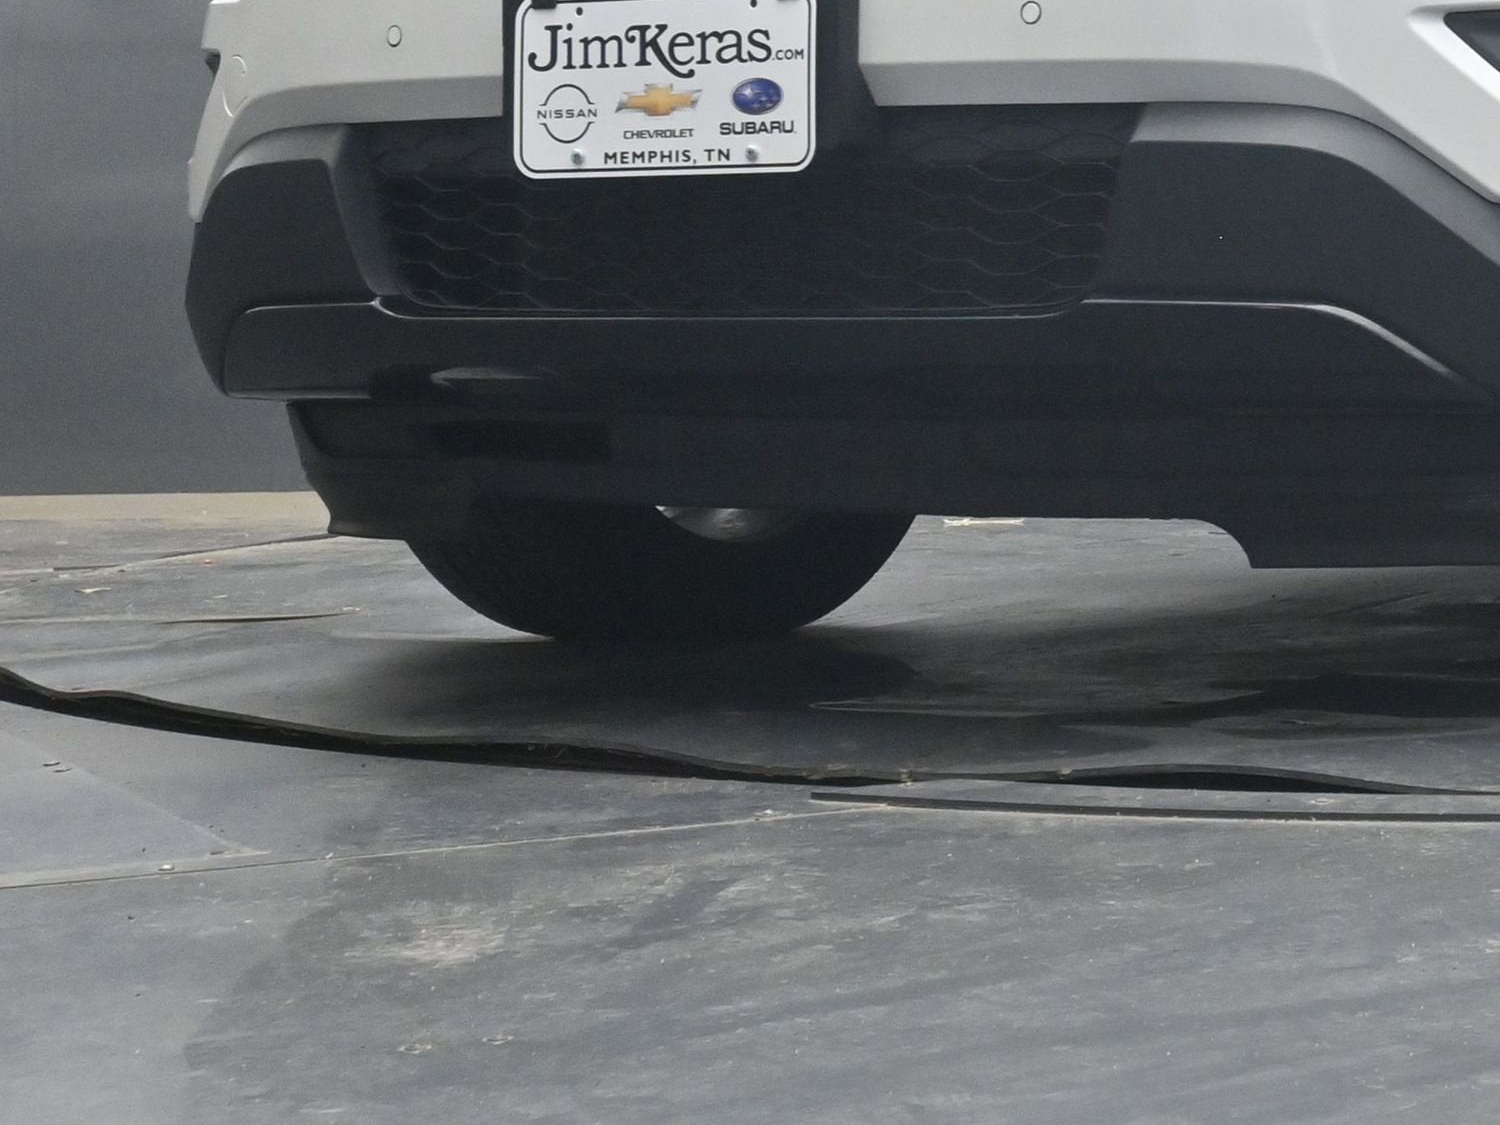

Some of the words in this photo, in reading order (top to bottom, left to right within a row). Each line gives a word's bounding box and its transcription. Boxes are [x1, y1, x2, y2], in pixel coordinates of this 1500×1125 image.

[536, 107, 598, 121] NISSAN
[623, 128, 695, 140] CHEVROLET
[719, 120, 795, 136] SUBARU
[603, 149, 697, 166] MEMPHIS,
[704, 148, 731, 163] TN
